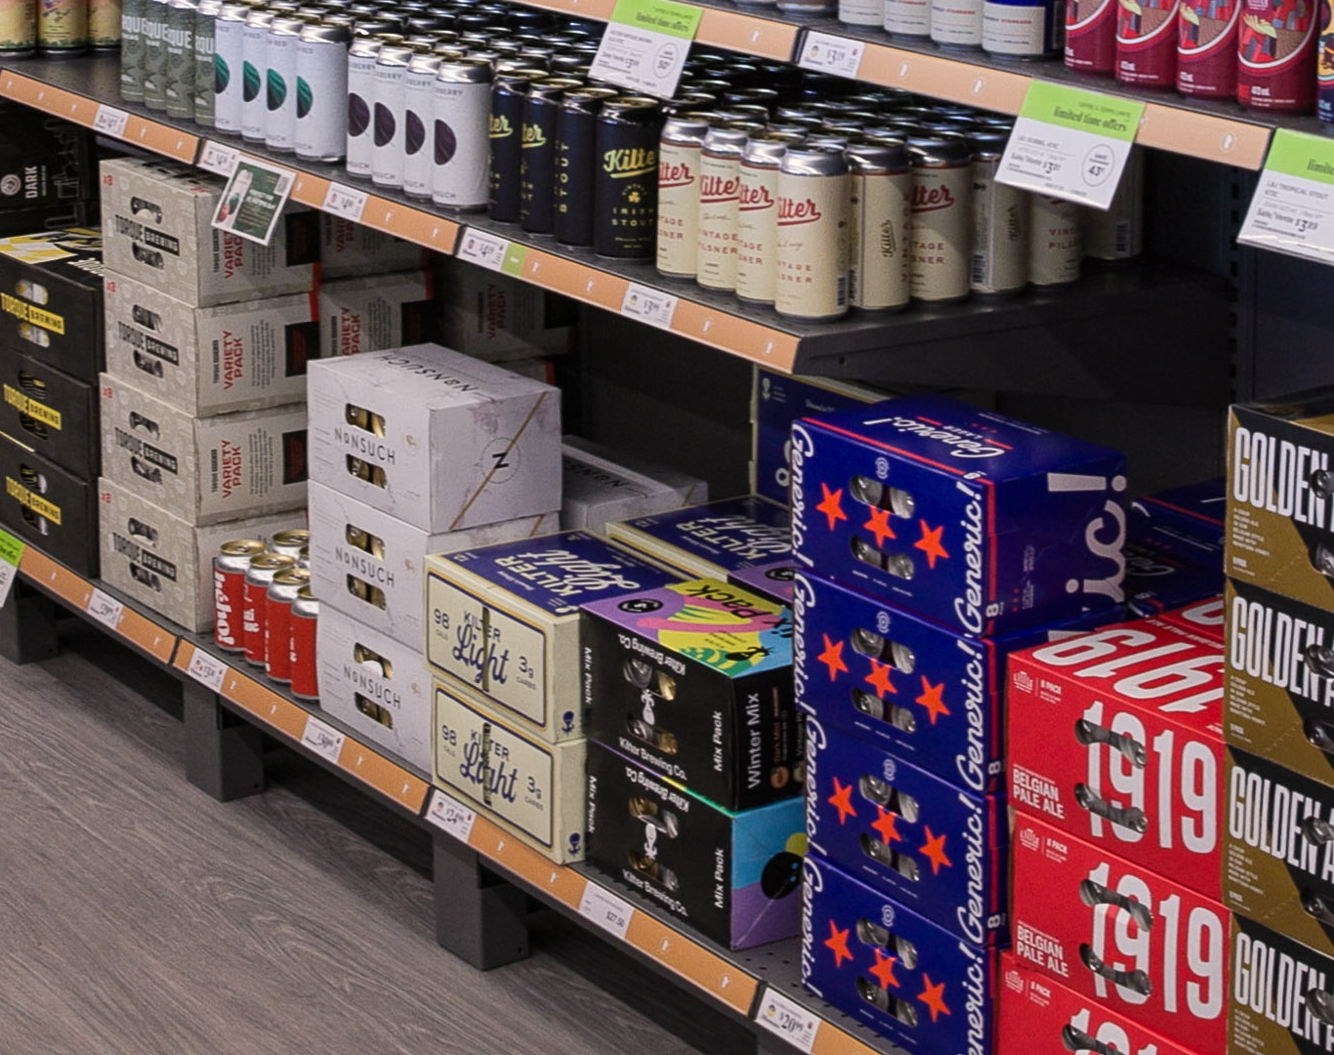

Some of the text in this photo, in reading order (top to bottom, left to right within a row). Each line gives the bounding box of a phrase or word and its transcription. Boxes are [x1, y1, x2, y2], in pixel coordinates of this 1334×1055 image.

[25, 165, 39, 199] DARK
[223, 330, 234, 390] VARIETY
[233, 338, 244, 378] PACK
[222, 439, 233, 498] VARIETY
[232, 446, 243, 488] PACK
[791, 423, 814, 568] Generic!
[1233, 427, 1329, 529] GOLDEN
[494, 555, 582, 596] KILTER
[954, 481, 985, 636] Generic!
[433, 608, 450, 630] 98
[793, 574, 817, 715] Generic!
[1230, 596, 1325, 702] GOLDEN
[452, 623, 510, 684] Light
[442, 724, 457, 747] 98
[712, 711, 723, 772] Mix Pack
[745, 693, 762, 789] Winter Mix
[957, 639, 985, 791] Generic!
[805, 718, 827, 858] Generic!
[1012, 768, 1059, 802] BELGIAN
[1013, 785, 1065, 820] PALE ALE
[1082, 700, 1217, 855] 1919
[1228, 765, 1323, 876] GOLDEN
[714, 848, 725, 909] Mix Pack
[957, 791, 985, 945] Generic!
[801, 859, 824, 998] Generic!
[1016, 923, 1063, 957] BELGIAN
[1089, 862, 1224, 1020] 1919
[1016, 943, 1069, 979] PALE ALE
[1233, 932, 1324, 1037] GOLDEN
